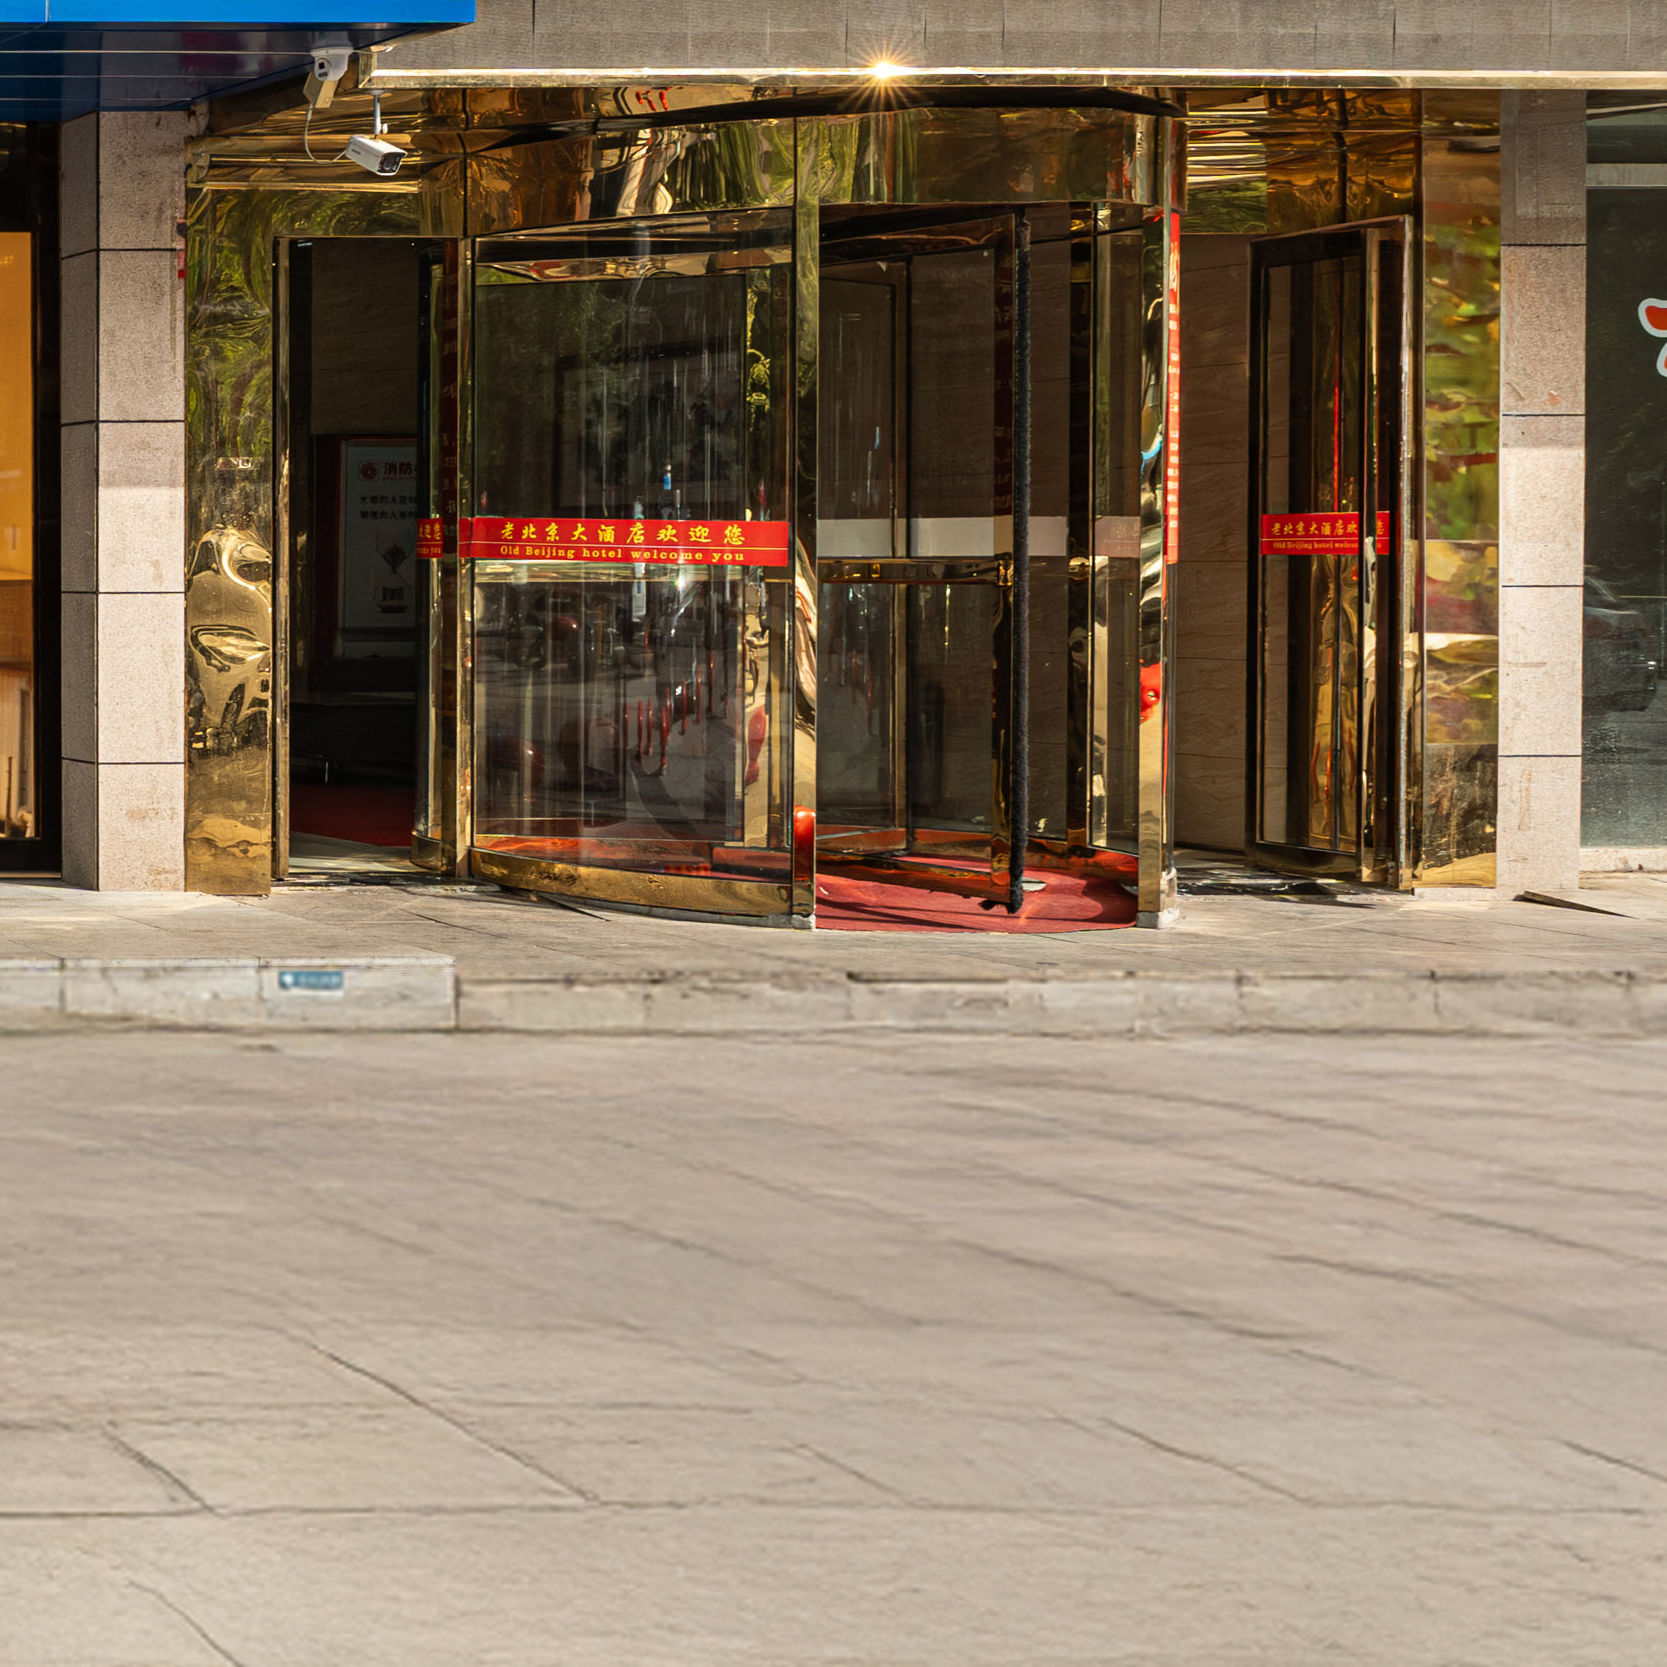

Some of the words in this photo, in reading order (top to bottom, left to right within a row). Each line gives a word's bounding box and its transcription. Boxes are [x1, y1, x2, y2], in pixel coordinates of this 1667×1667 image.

[383, 461, 418, 476] 消防
[500, 521, 746, 546] 老北京大酒店欢迎您
[500, 545, 520, 556] Old
[525, 545, 576, 560] Beijing
[582, 547, 622, 559] hotel
[630, 549, 704, 561] welcome
[711, 552, 745, 563] you
